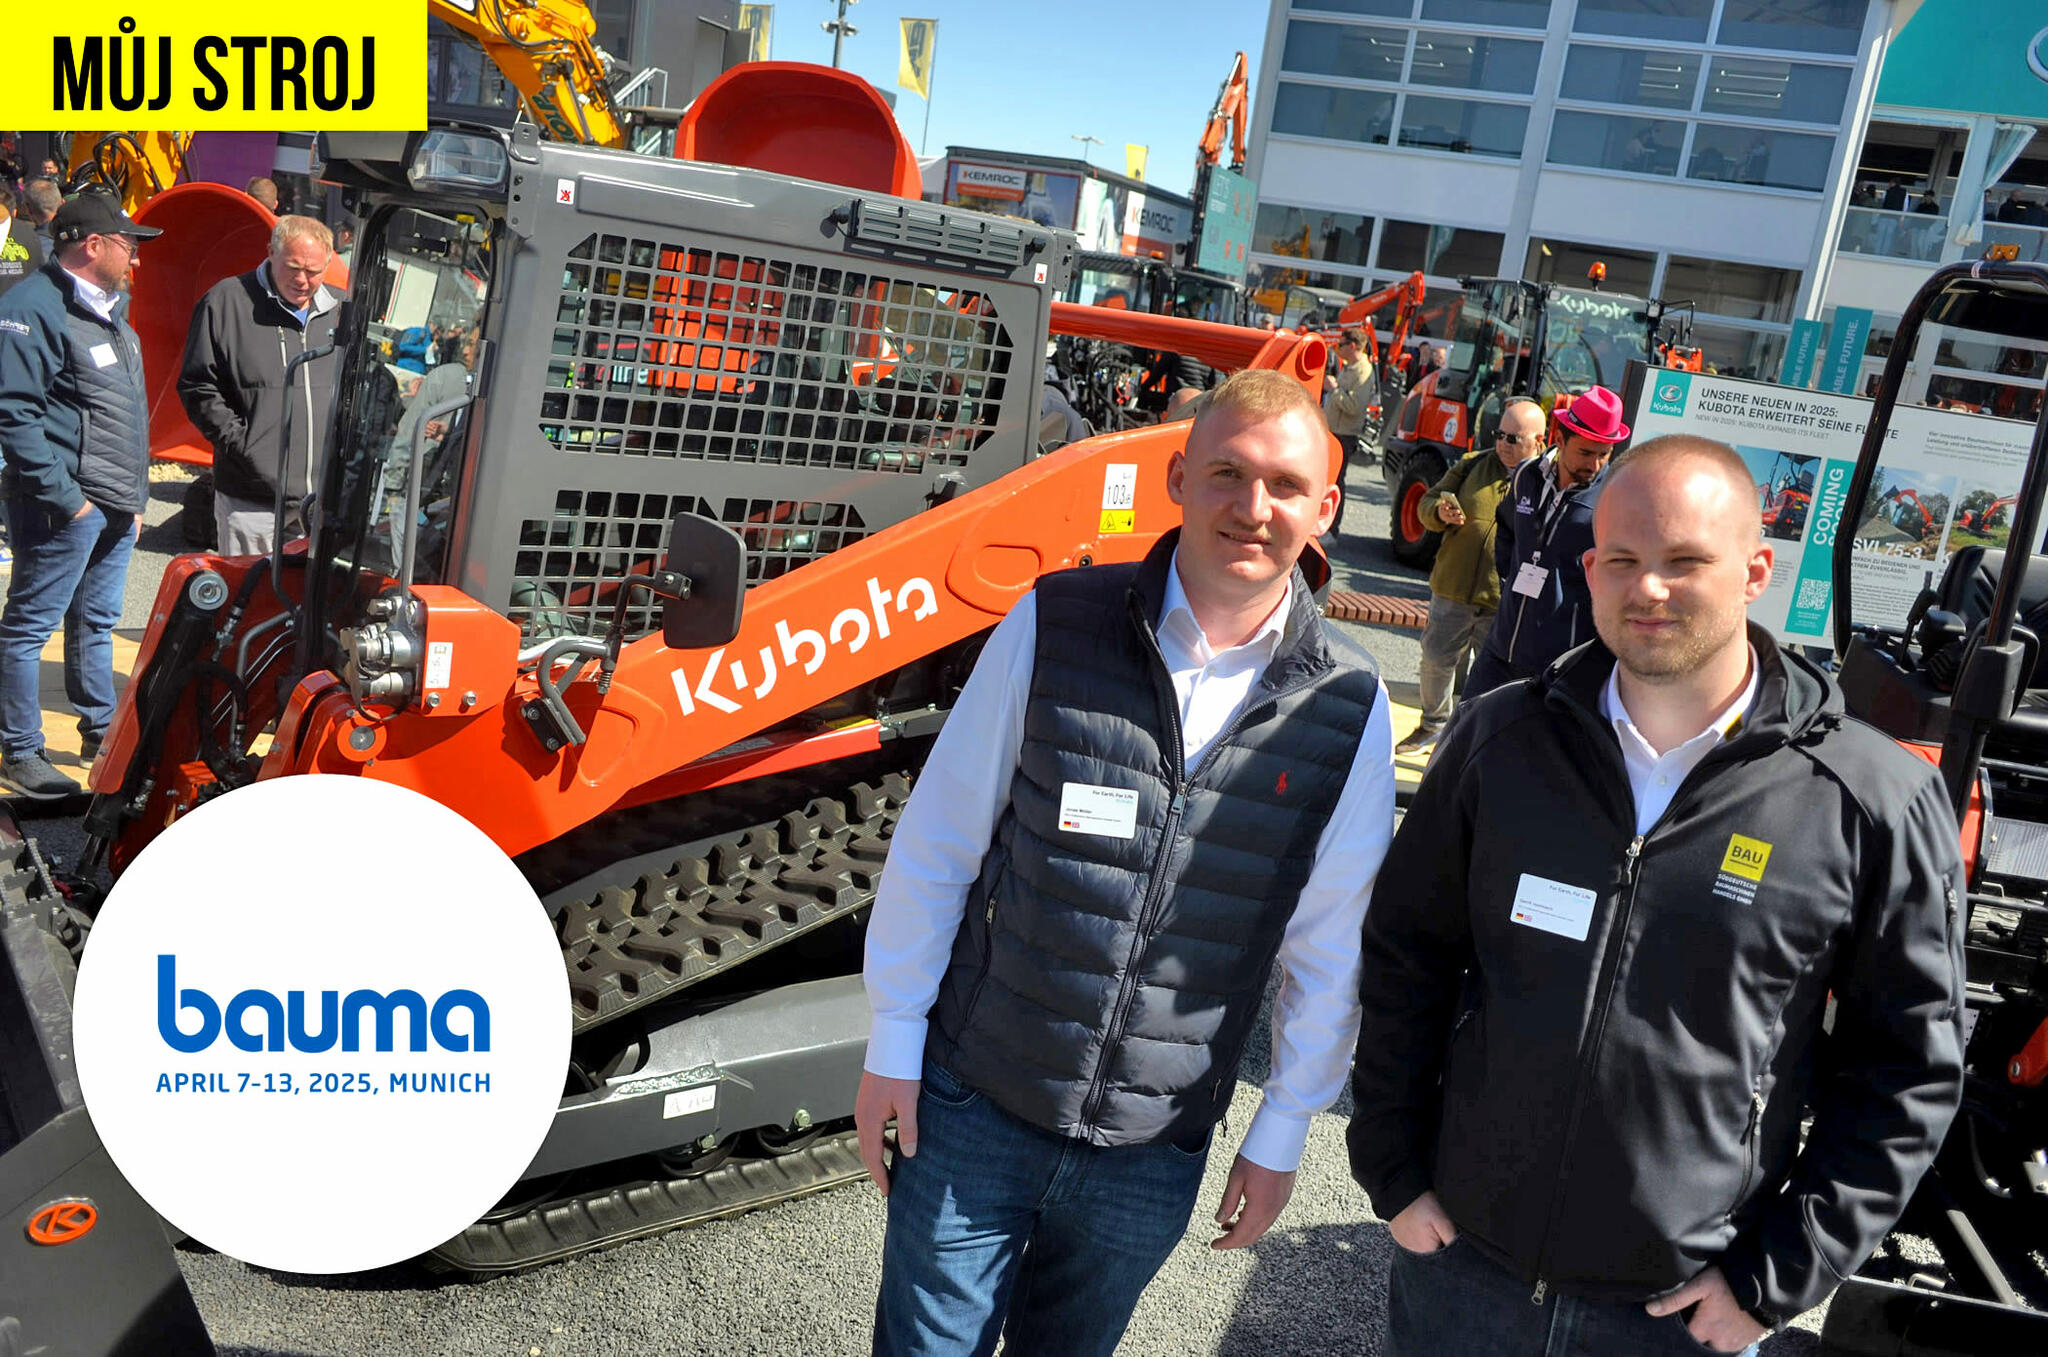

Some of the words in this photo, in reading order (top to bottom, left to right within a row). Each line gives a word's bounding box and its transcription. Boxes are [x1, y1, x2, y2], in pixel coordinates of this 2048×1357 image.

[963, 170, 1020, 185] KEMROC
[1131, 205, 1176, 233] KEMROC
[1653, 402, 1682, 414] Kubota
[1701, 388, 1749, 404] UNSERE
[1752, 396, 1792, 412] NEUEN
[1794, 401, 1806, 413] IN
[1809, 403, 1838, 418] 2025:
[1698, 401, 1746, 418] KUBOTA
[1748, 408, 1816, 428] ERWEITERT
[1817, 418, 1851, 434] SEINE
[1813, 468, 1844, 545] COMING
[1886, 543, 1922, 560] 75-3
[671, 577, 938, 717] Kubota
[1732, 846, 1763, 864] BAU
